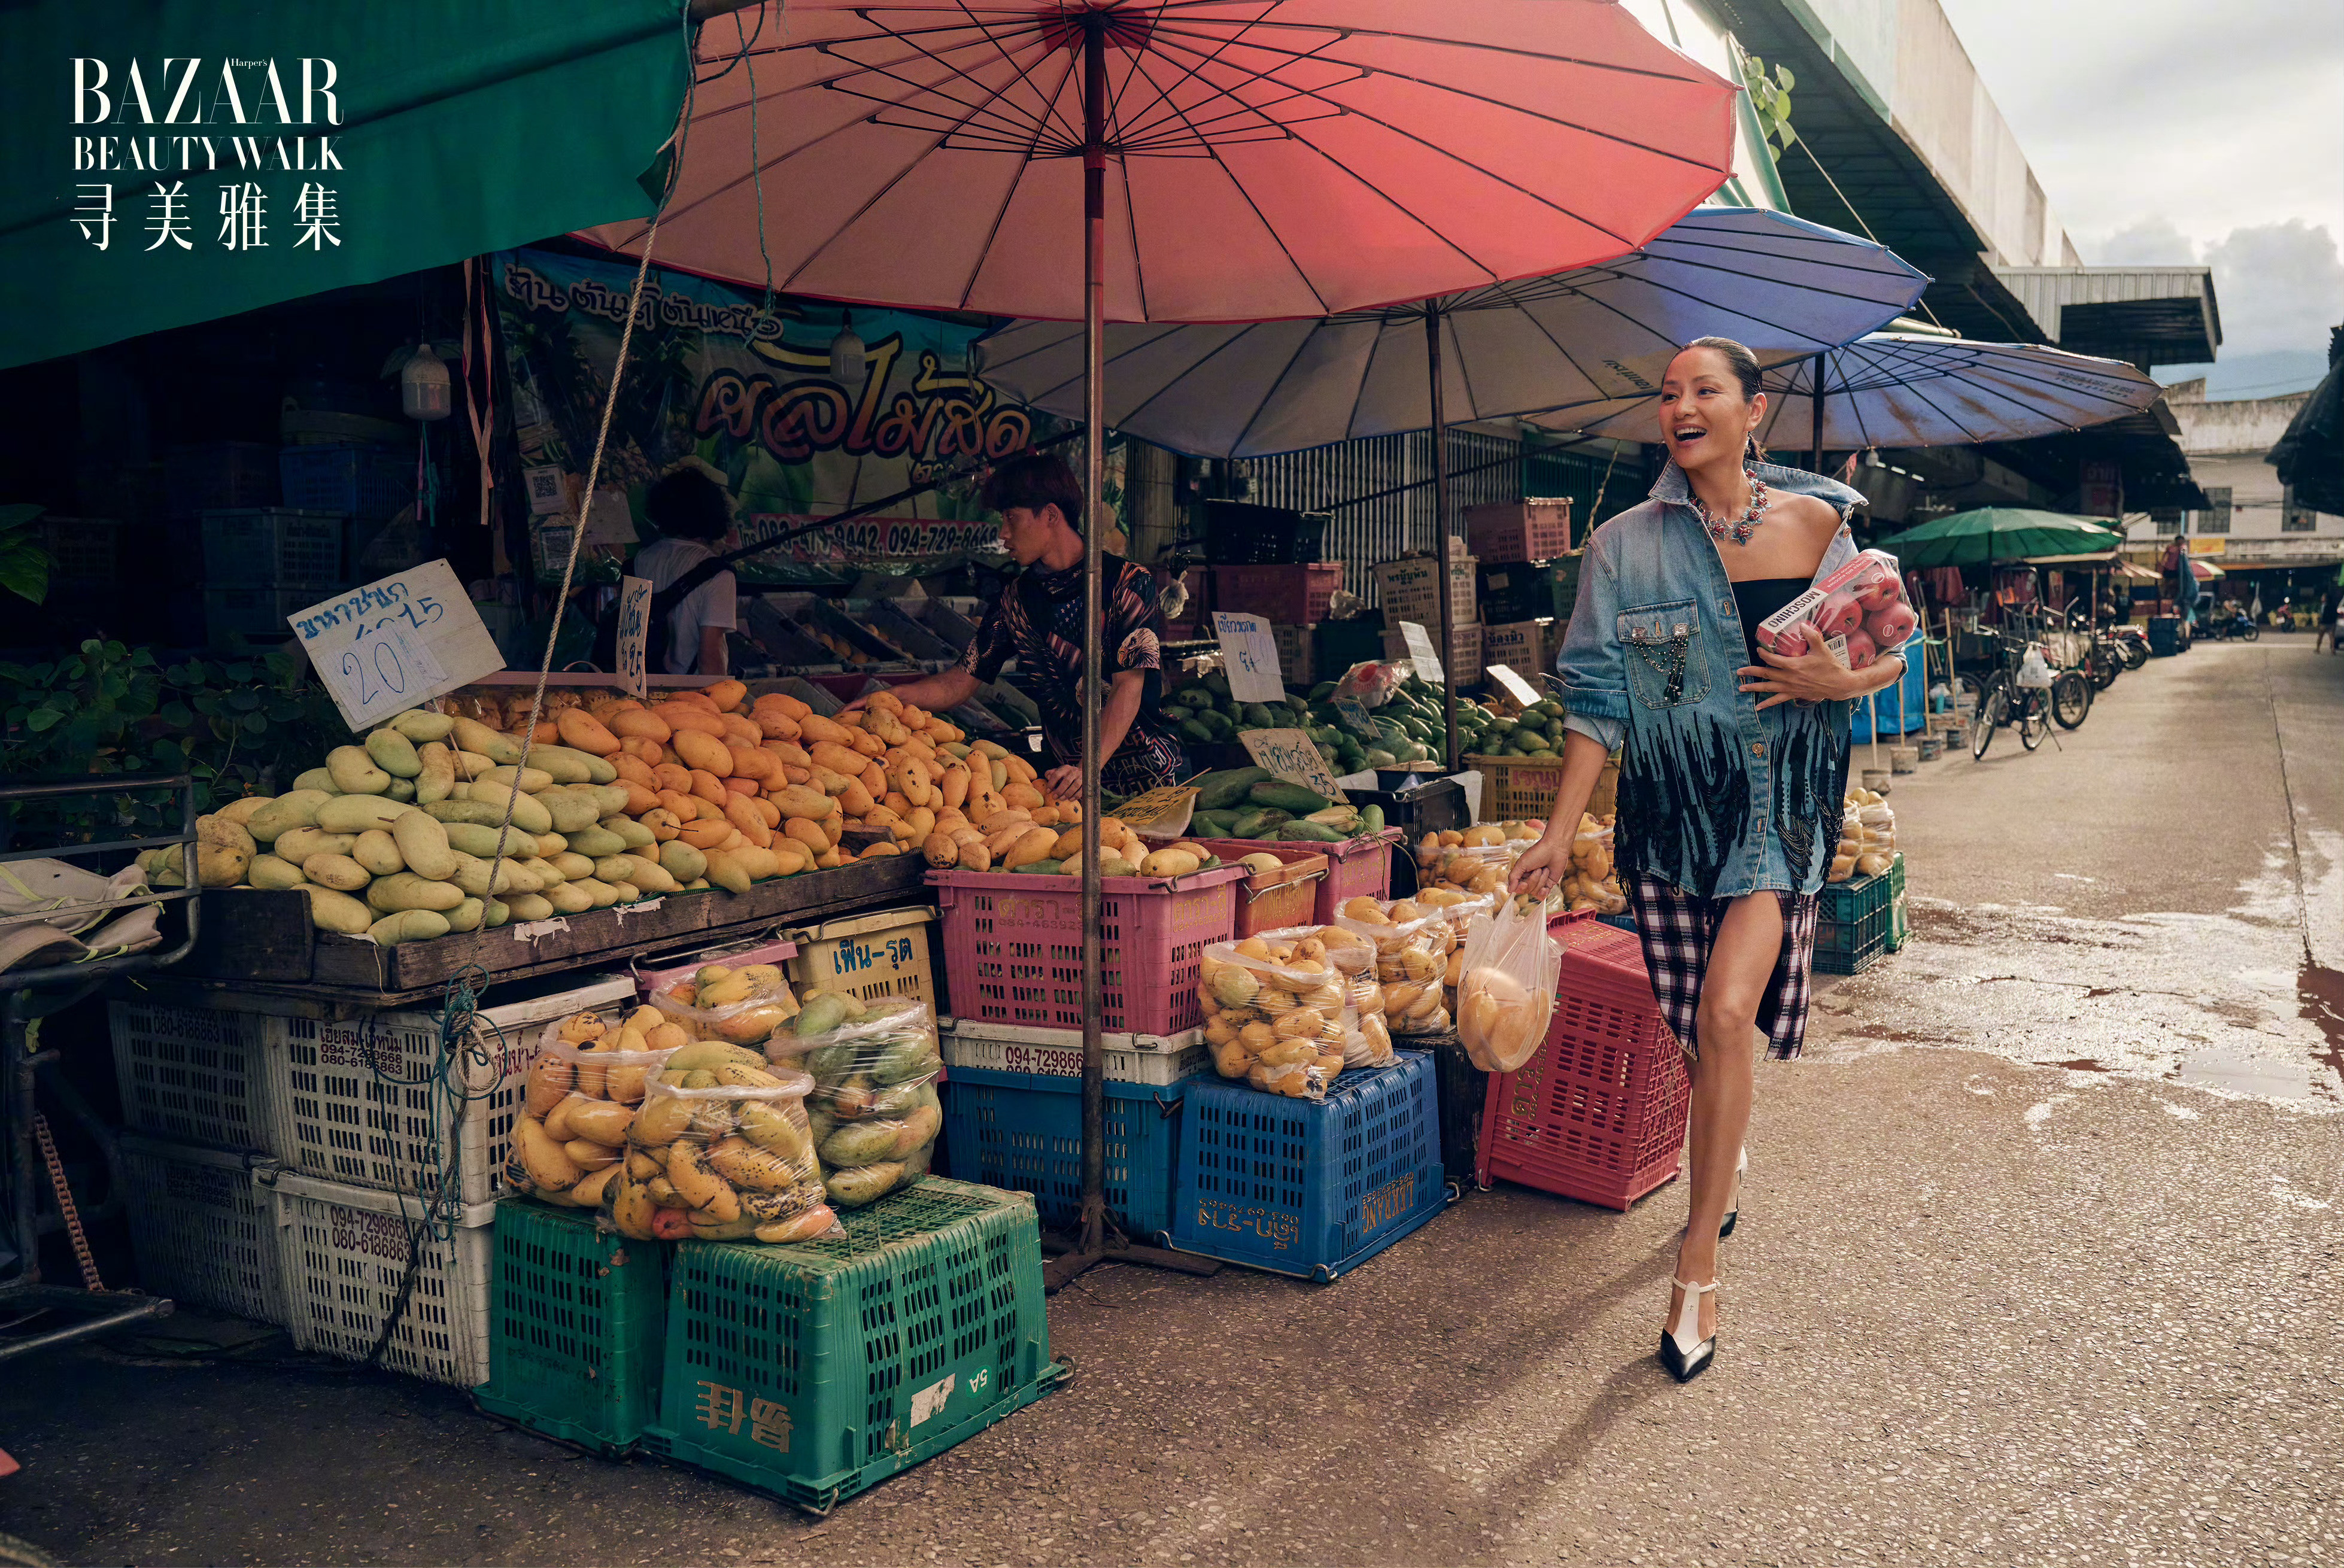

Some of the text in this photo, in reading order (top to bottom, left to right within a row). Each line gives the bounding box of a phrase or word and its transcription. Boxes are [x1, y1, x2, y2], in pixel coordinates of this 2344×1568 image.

[1768, 591, 1820, 628] MOSCHINO
[343, 642, 405, 704] 20
[154, 1016, 220, 1043] 080-6186863
[330, 1205, 409, 1242] 094-7298668
[1362, 1180, 1414, 1234] LEKRANG
[332, 1227, 411, 1263] 080-6186863
[968, 1367, 989, 1394] 5A
